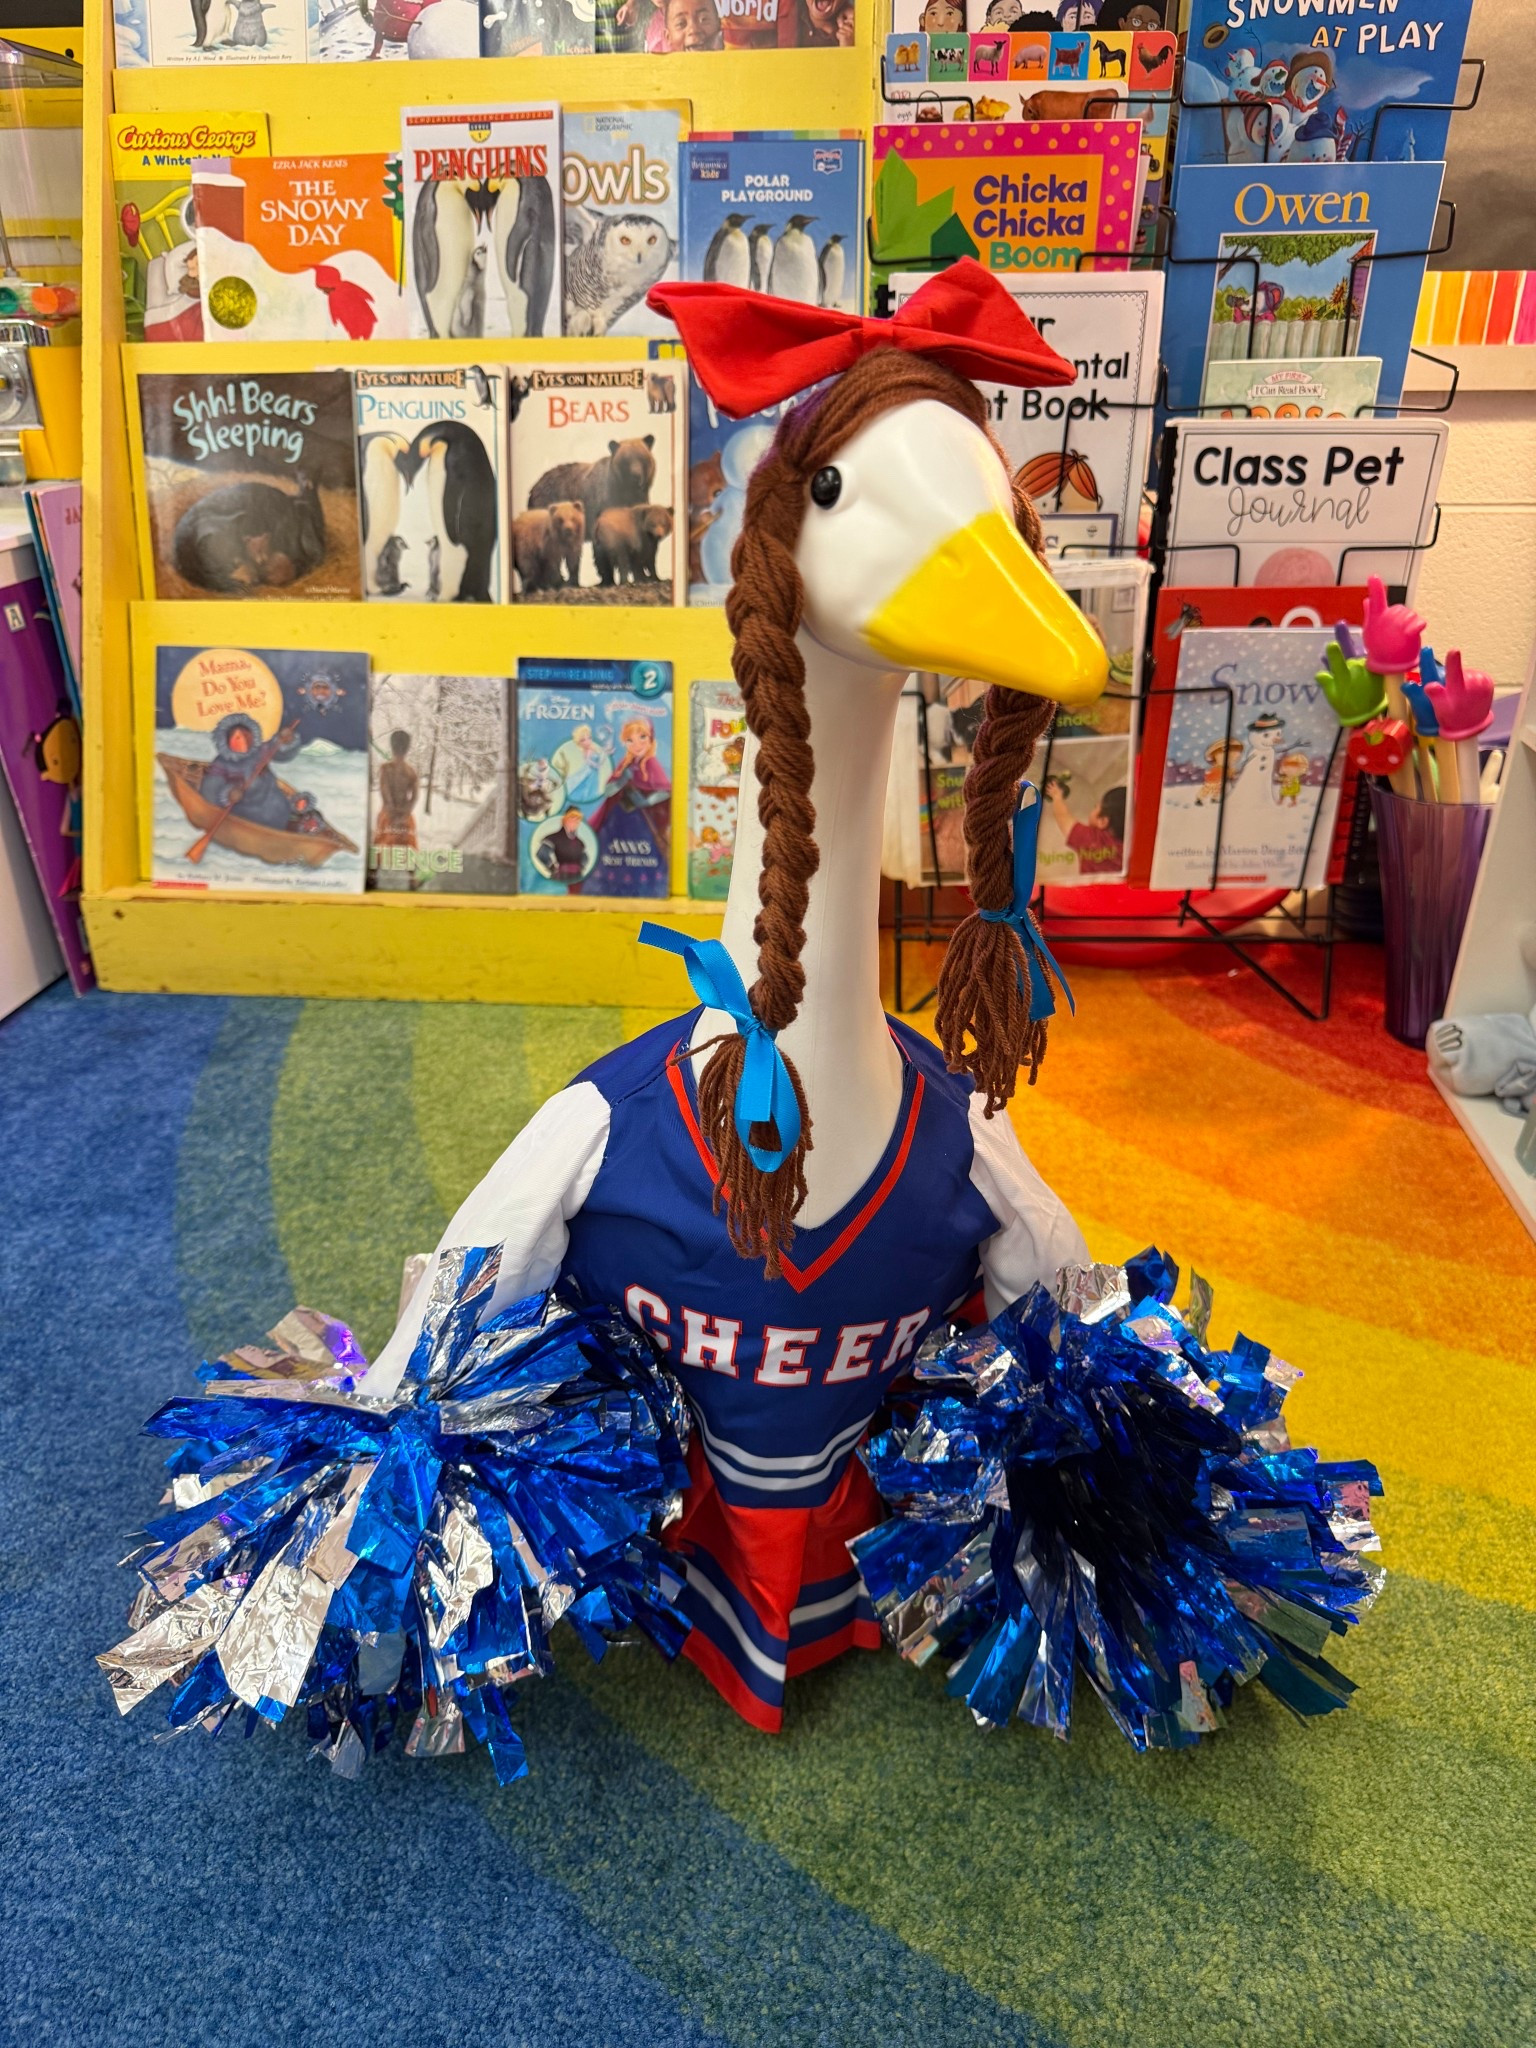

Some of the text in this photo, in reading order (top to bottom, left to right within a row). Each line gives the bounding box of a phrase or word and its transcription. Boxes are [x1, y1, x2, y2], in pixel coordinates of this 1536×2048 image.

[1311, 20, 1444, 54] AT PLAY
[117, 125, 257, 155] Curious George
[142, 155, 151, 166] A
[272, 159, 349, 170] EZRA JACK KEATS
[413, 144, 548, 183] PENGUINS
[288, 179, 337, 197] THE
[563, 146, 668, 205] Owls
[744, 174, 790, 188] POLAR
[974, 172, 1088, 206] Chicka
[720, 188, 814, 203] PLAYGROUND
[1233, 182, 1371, 226] Owen
[260, 198, 370, 222] SNOWY
[973, 207, 1086, 239] Chicka
[287, 223, 346, 247] DAY
[989, 241, 1084, 269] Boom
[357, 369, 466, 390] EYES ON NATURE
[532, 368, 644, 391] EYES ON NATURE
[1260, 385, 1277, 396] Can
[1278, 384, 1297, 395] Read
[1299, 383, 1320, 395] Book
[172, 380, 319, 431] Shh! Bears
[356, 393, 467, 426] PENGUINS
[547, 395, 631, 428] BEARS
[1021, 387, 1112, 421] Book
[186, 418, 305, 464] Sleeping
[1194, 446, 1405, 487] Class Pet
[1226, 485, 1372, 537] Journal
[198, 659, 252, 678] Mama,
[527, 668, 551, 680] STEP
[642, 669, 658, 690] 2
[201, 676, 256, 697] Do You
[1209, 663, 1321, 706] Snow
[196, 690, 267, 717] Love Me?
[525, 702, 595, 721] FROZEN
[1056, 711, 1100, 728] snack
[368, 846, 464, 873] TIENCE
[1038, 850, 1075, 864] lying
[623, 1283, 932, 1388] CHEER
